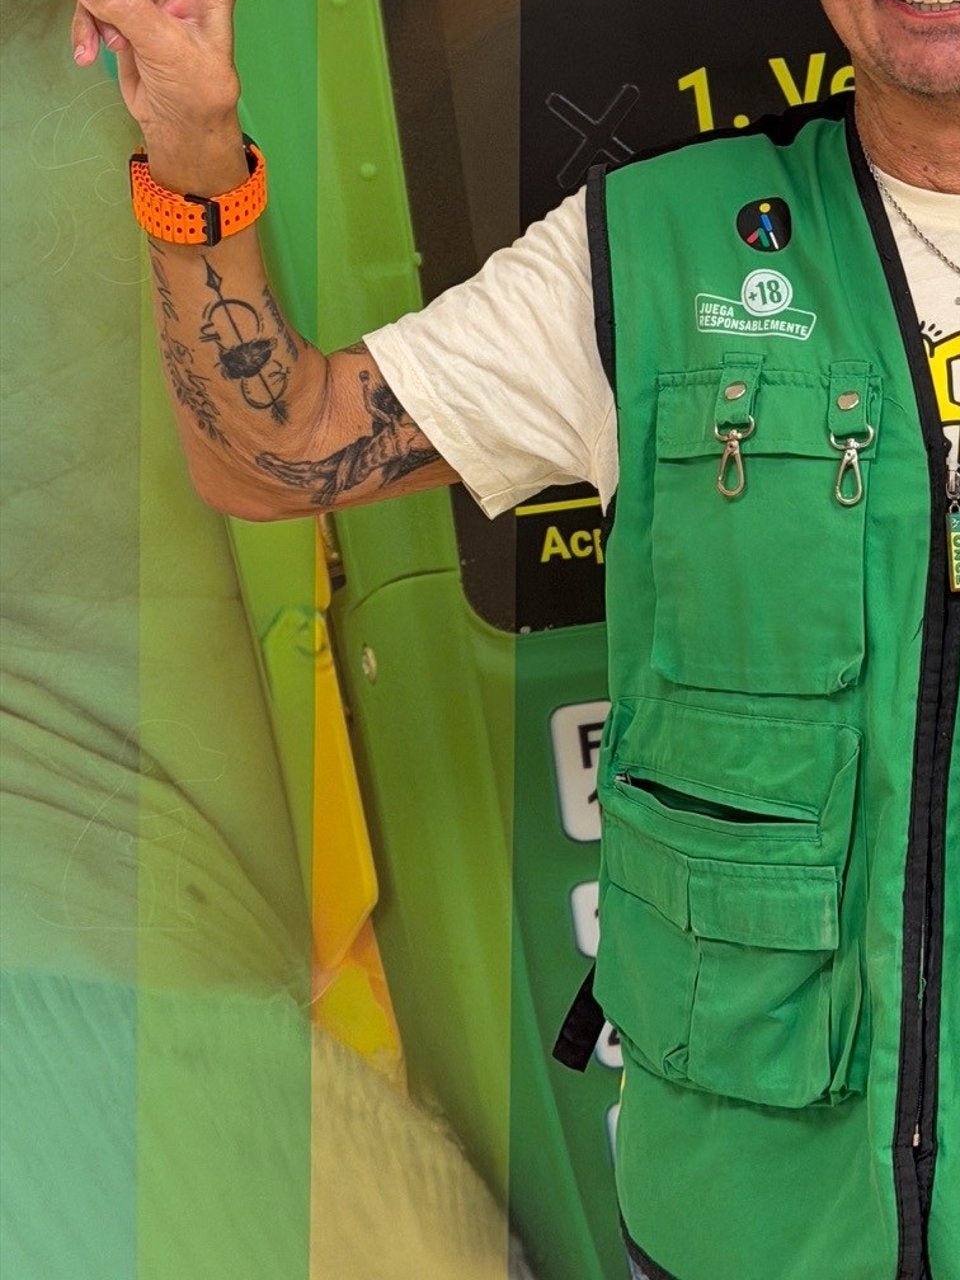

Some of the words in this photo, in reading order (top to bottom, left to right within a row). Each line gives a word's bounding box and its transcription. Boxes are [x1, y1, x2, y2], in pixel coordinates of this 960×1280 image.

[749, 279, 782, 306] +18
[699, 302, 735, 317] JUEGA
[699, 314, 809, 337] RESPONSABLEMENTE
